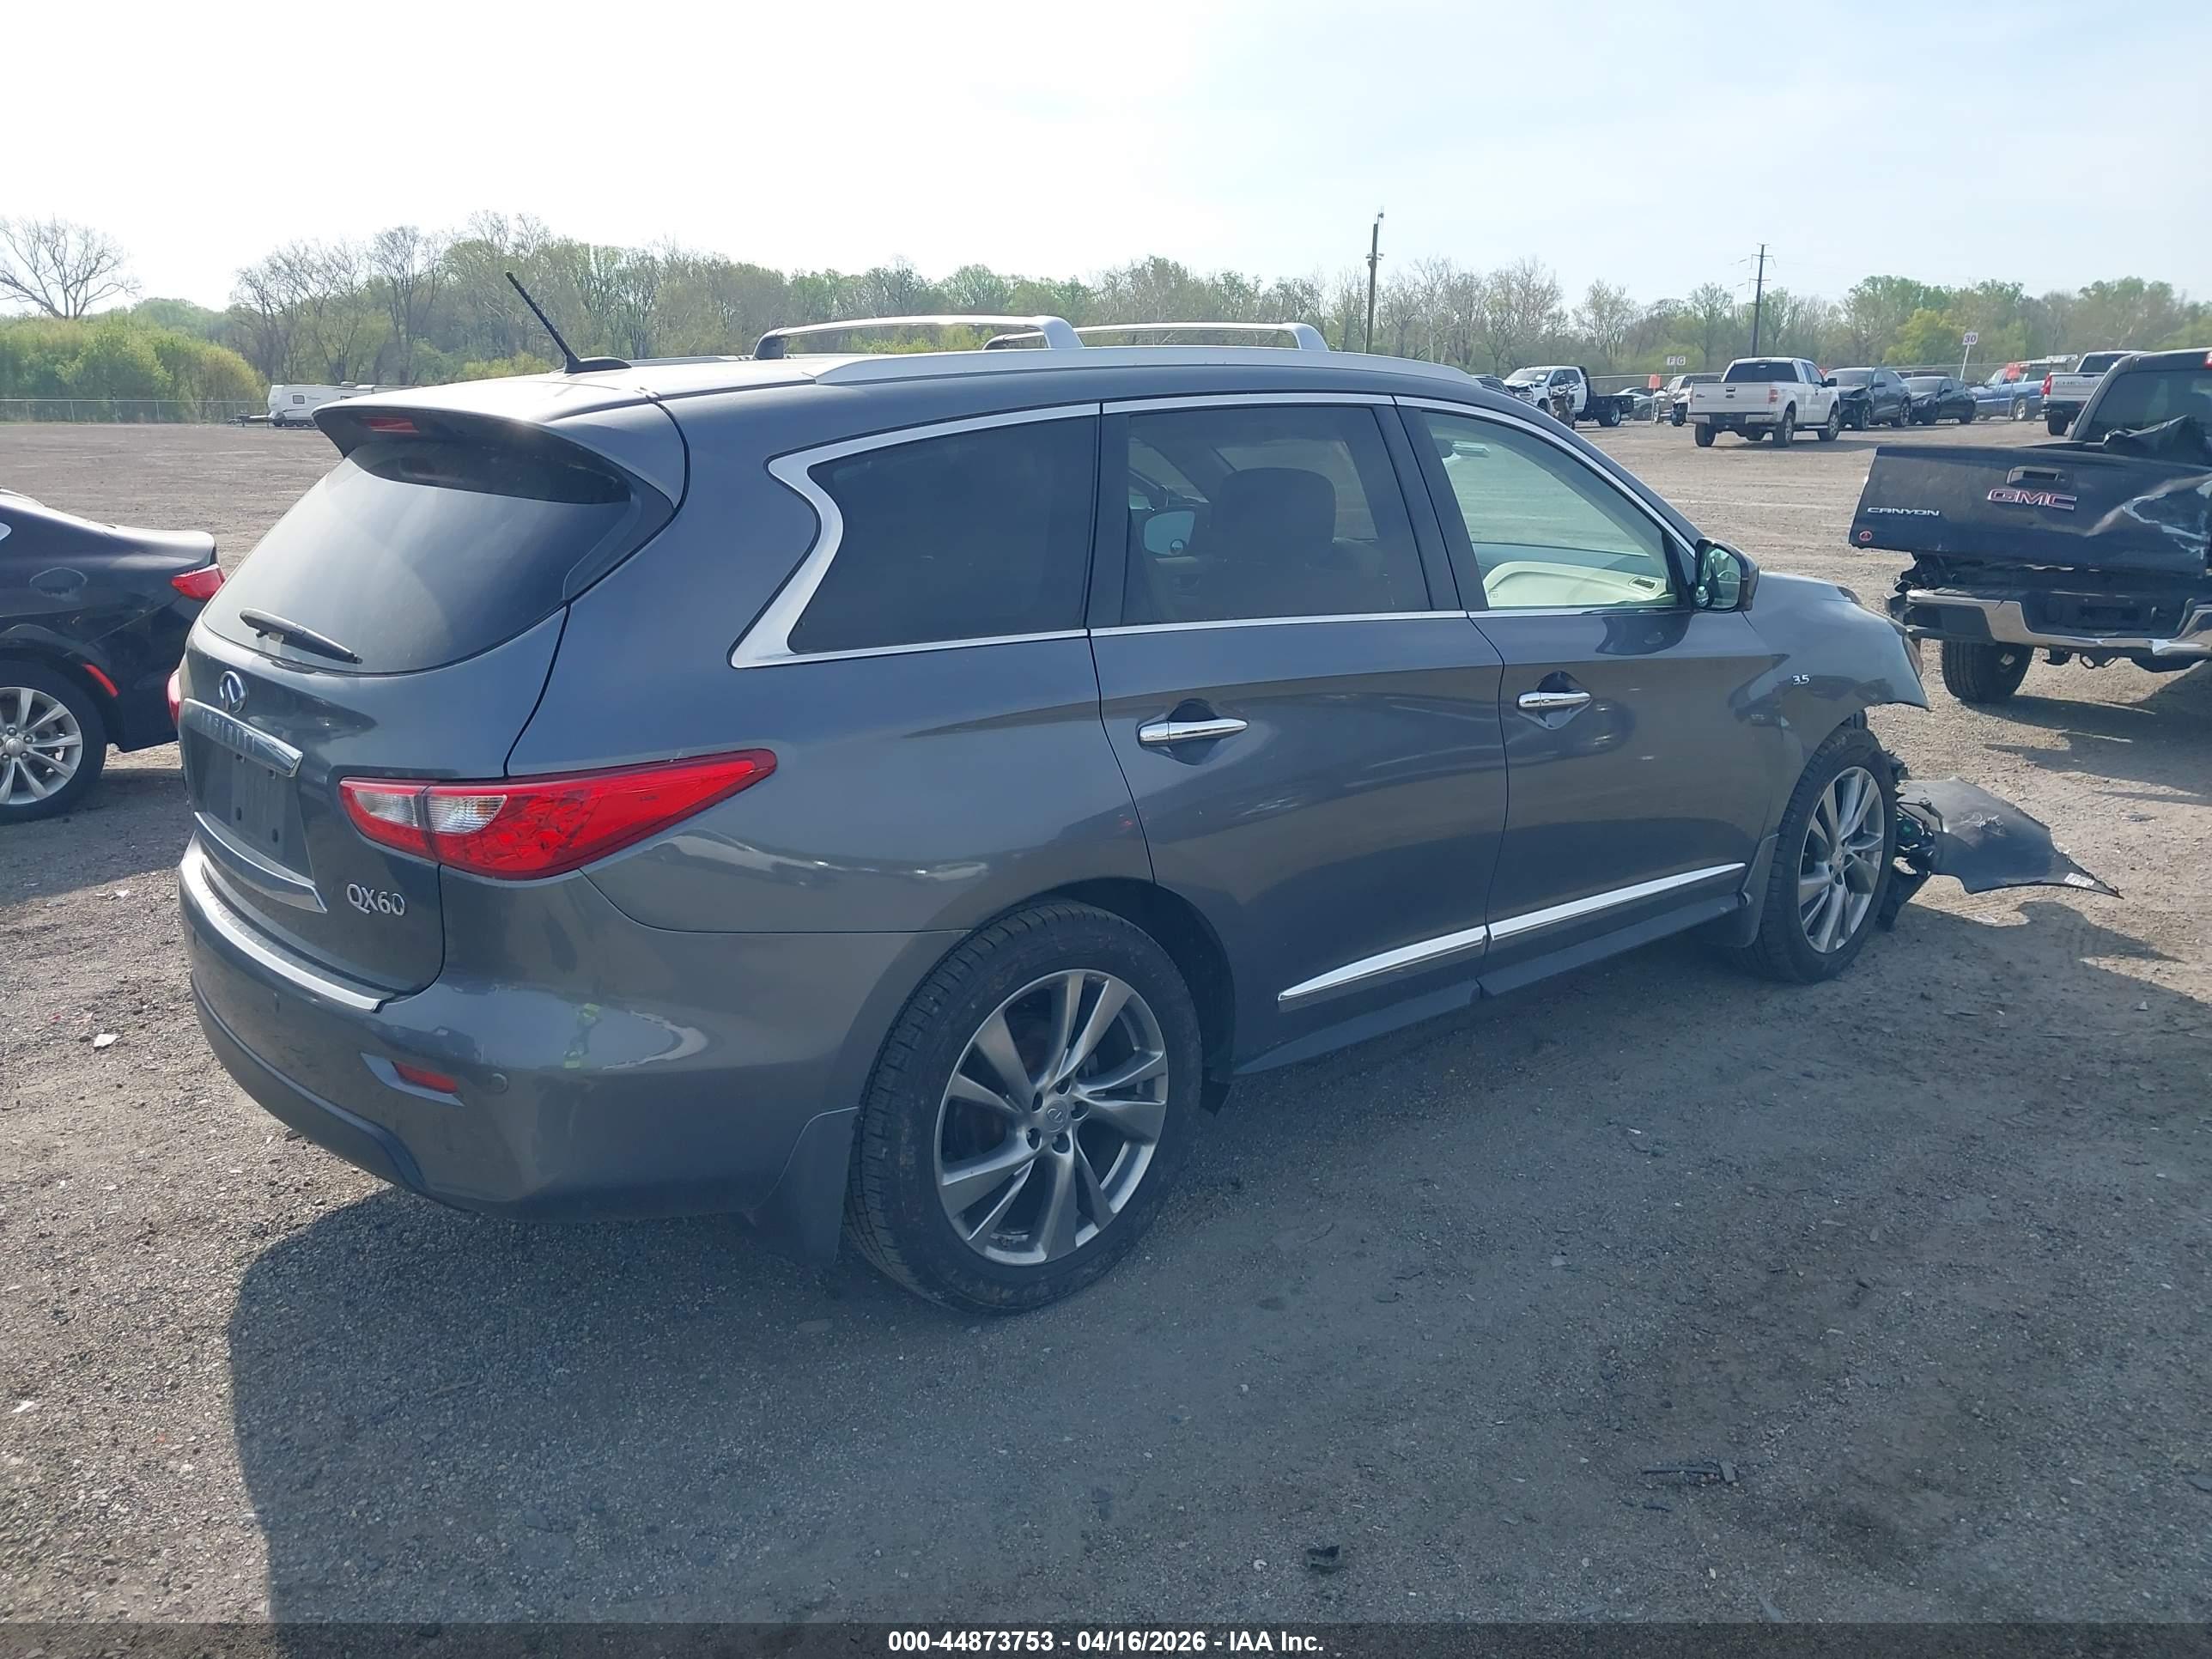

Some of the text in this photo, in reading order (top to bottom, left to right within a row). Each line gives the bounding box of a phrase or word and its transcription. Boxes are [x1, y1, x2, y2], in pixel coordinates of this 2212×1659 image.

[1964, 335, 1977, 343] 30
[1678, 356, 1685, 365] G
[1987, 489, 2077, 512] GMC
[1867, 507, 1940, 516] CANYON
[200, 710, 255, 753] INFINITI
[347, 884, 405, 916] QX60
